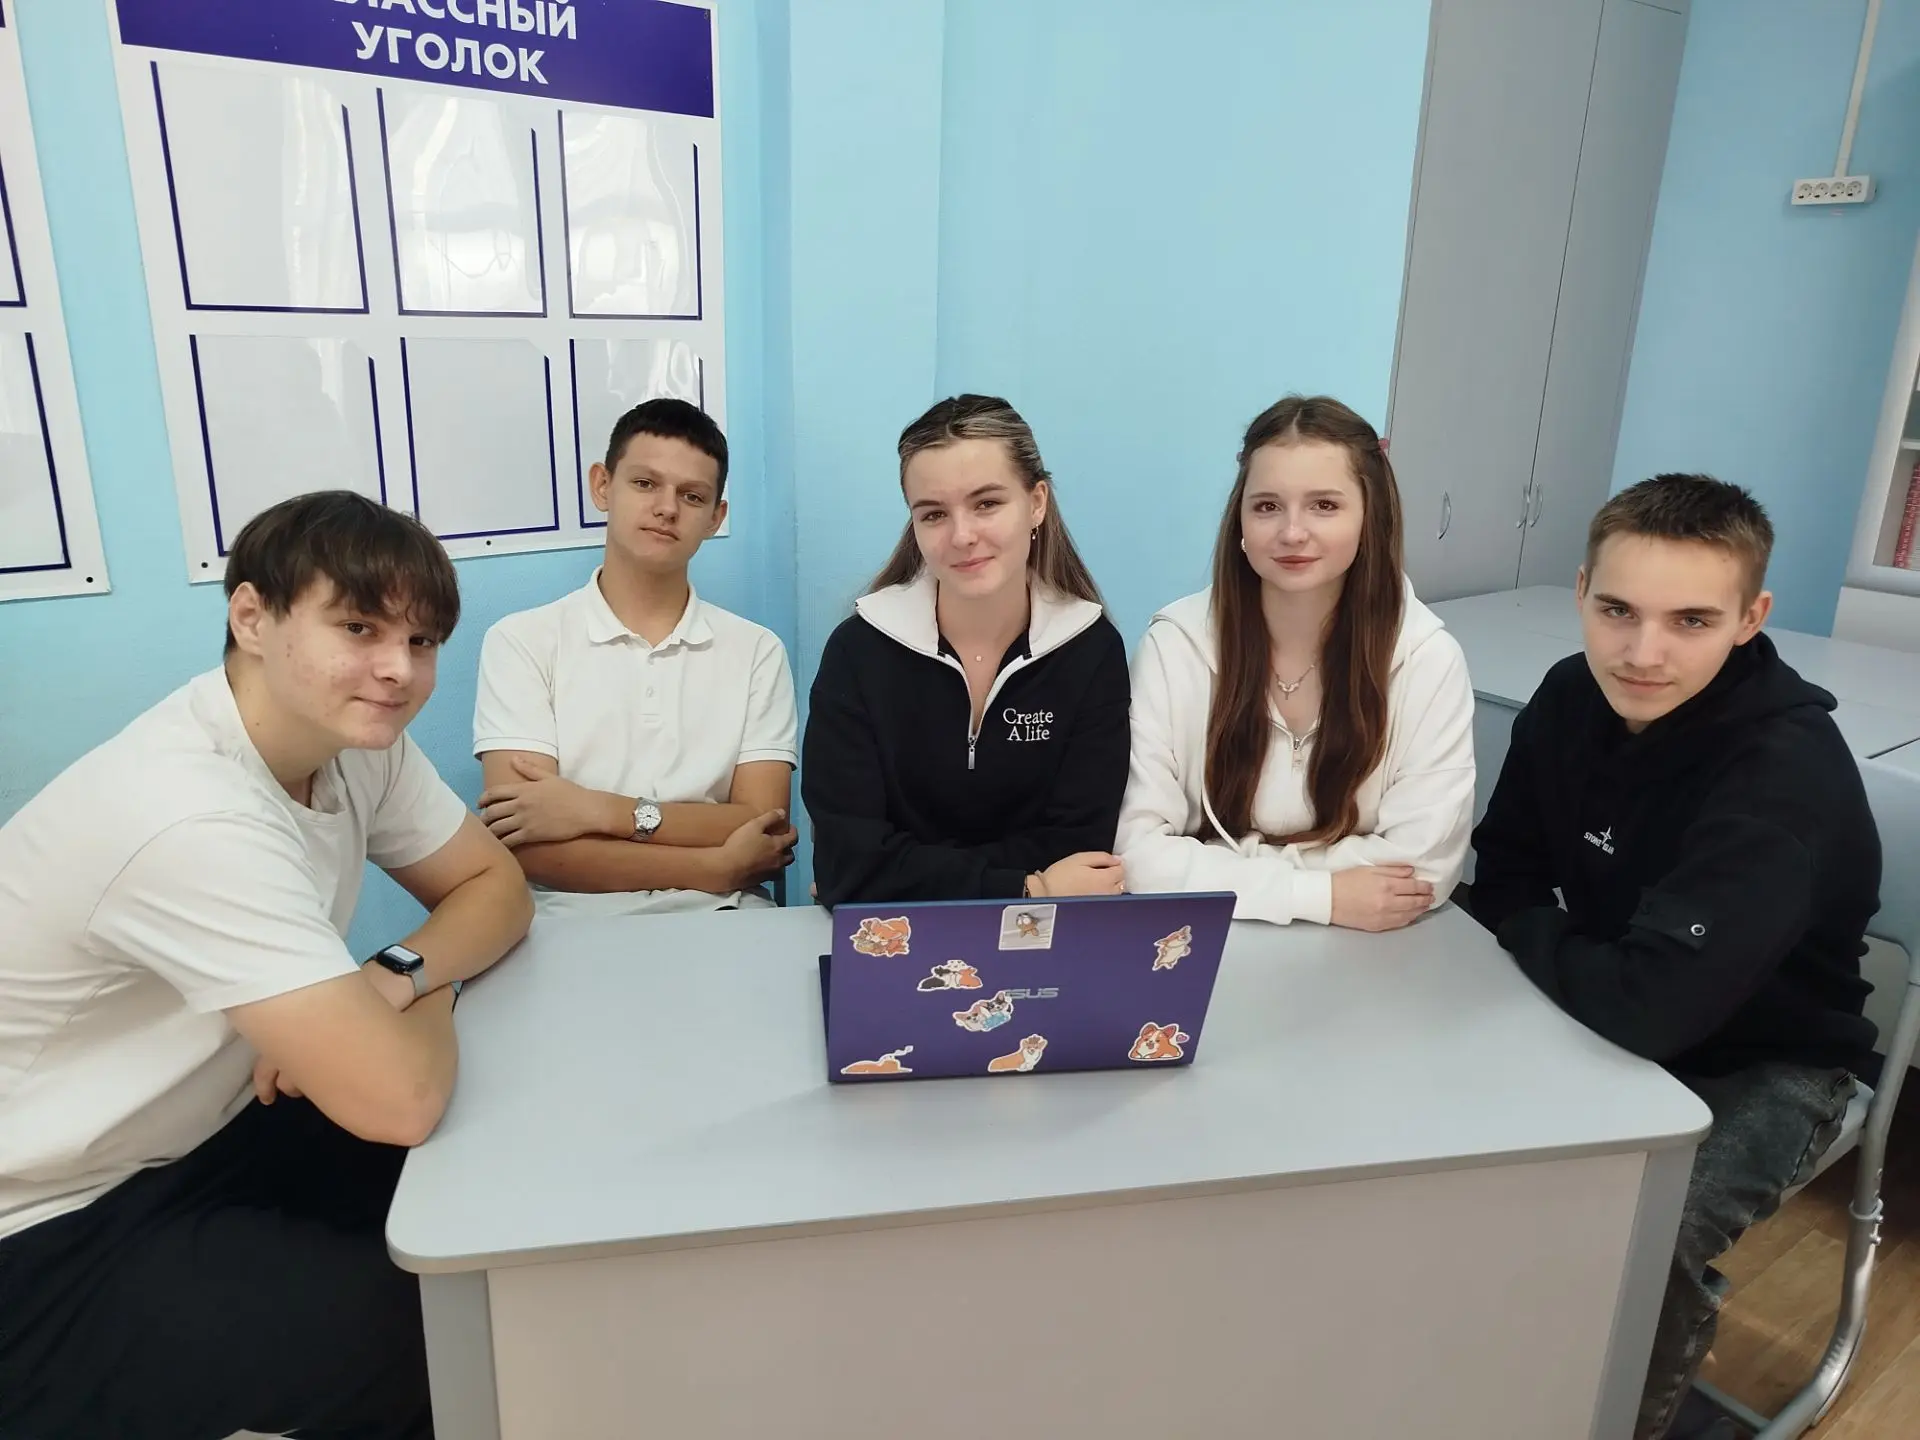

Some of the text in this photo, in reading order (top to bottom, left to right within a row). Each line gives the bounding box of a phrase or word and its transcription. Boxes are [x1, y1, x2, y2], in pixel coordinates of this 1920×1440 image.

[352, 21, 549, 85] УГОЛОК
[1003, 708, 1054, 725] Create
[1007, 724, 1050, 741] A life
[1004, 987, 1059, 999] SUS
